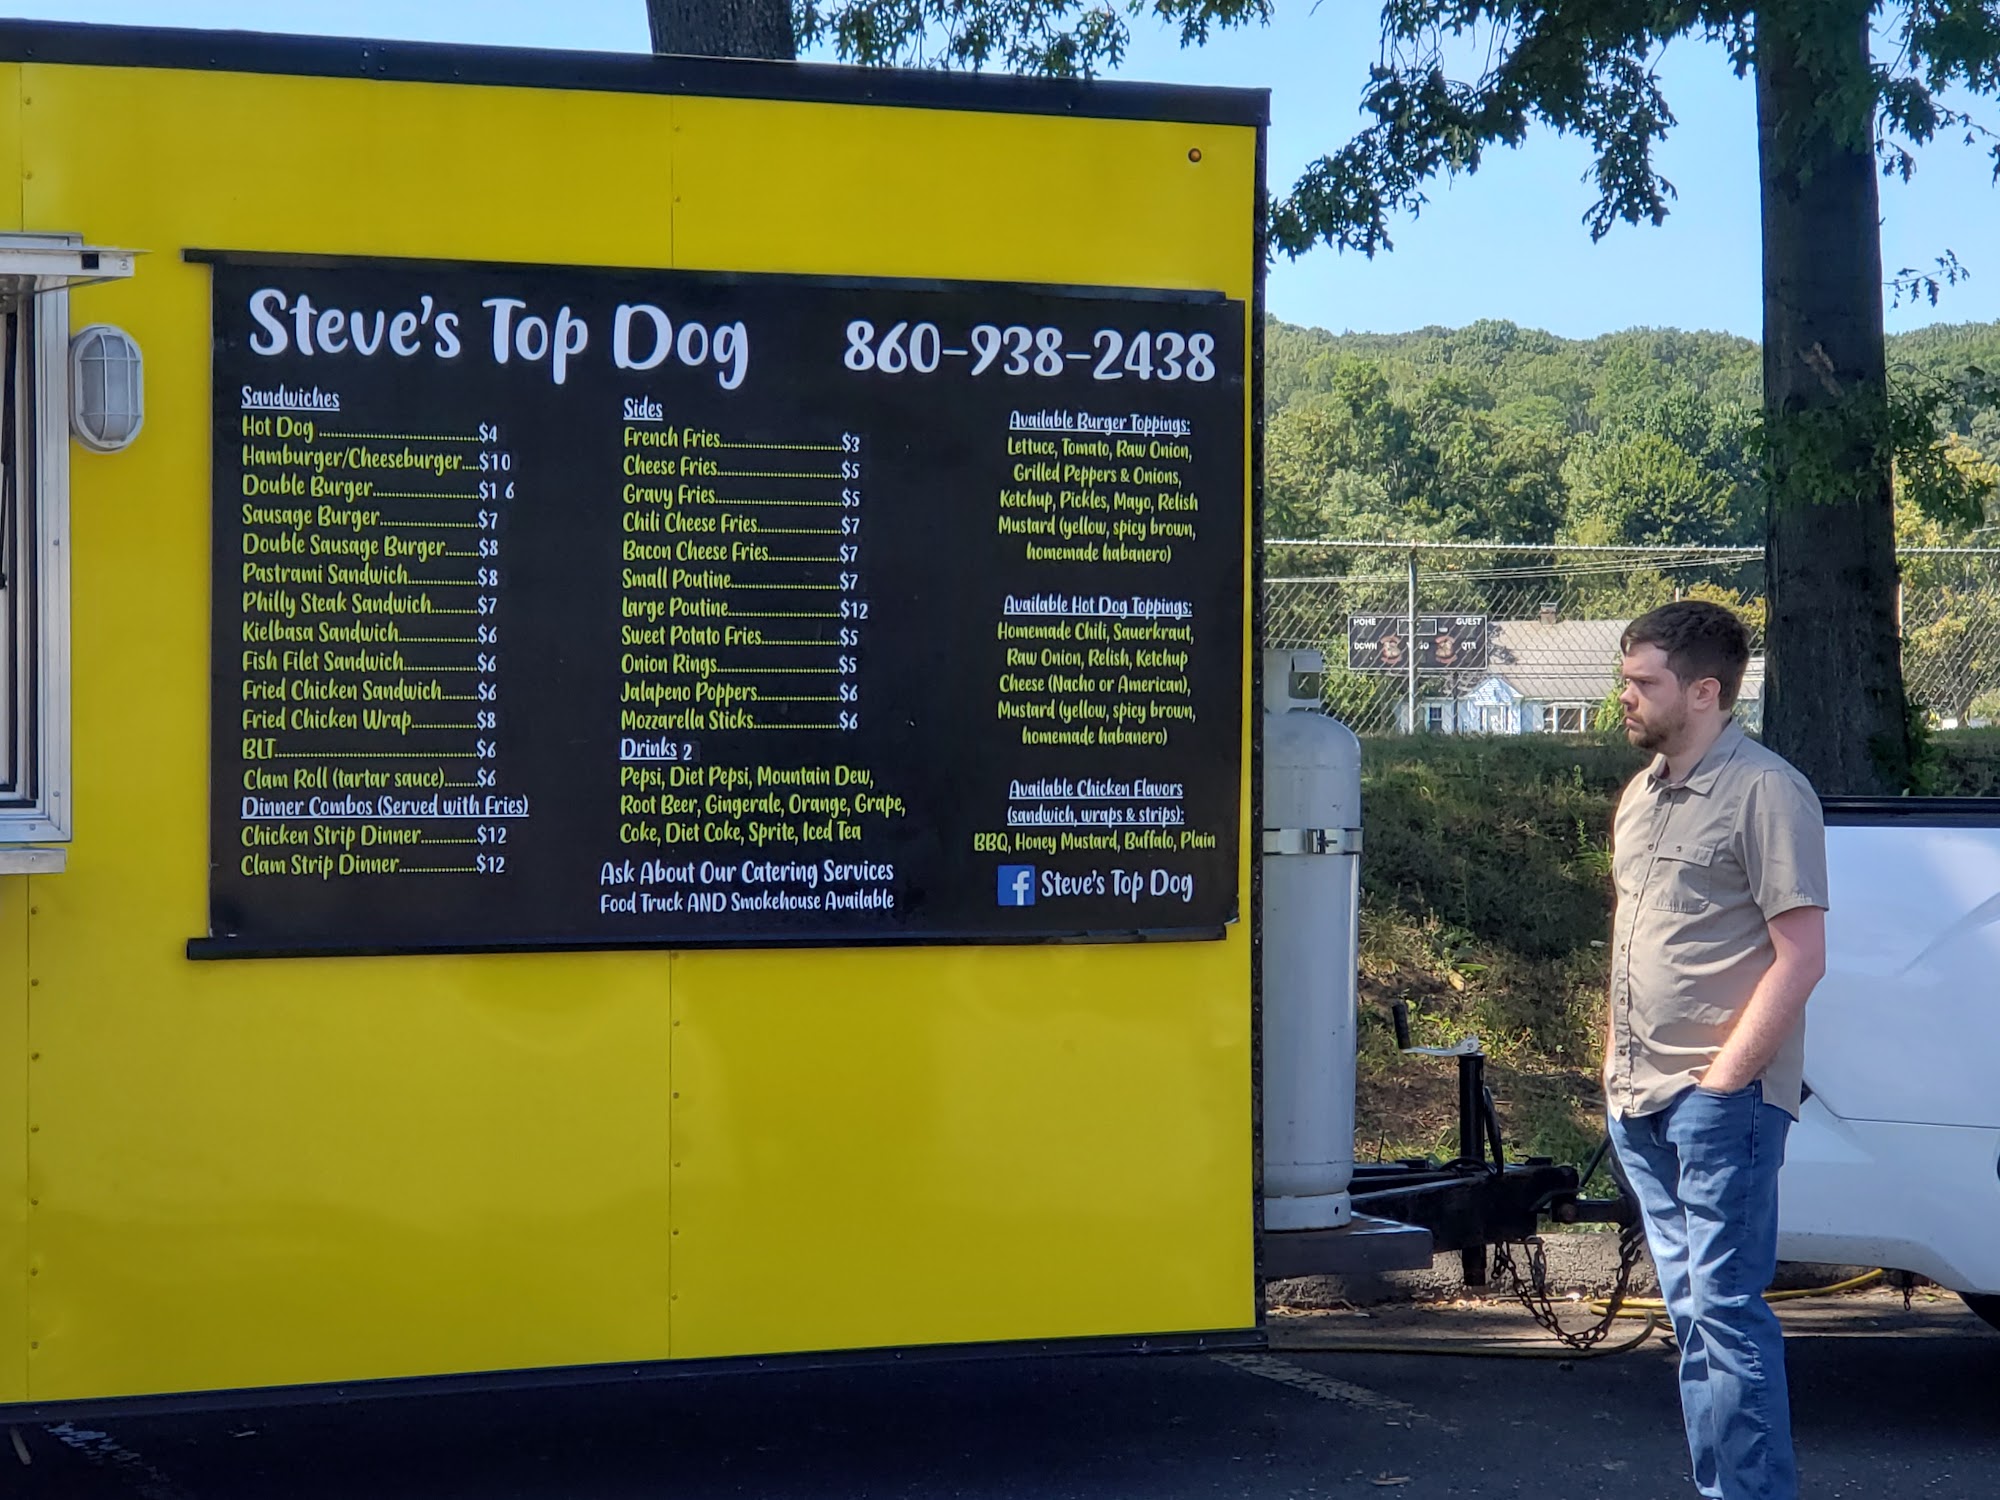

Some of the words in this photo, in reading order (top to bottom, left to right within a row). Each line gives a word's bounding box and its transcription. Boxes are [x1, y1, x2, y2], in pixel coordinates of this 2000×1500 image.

[249, 288, 462, 358] Steve's
[482, 298, 589, 385] Top
[612, 304, 749, 390] Dog
[843, 319, 1217, 383] 860-938-2438
[242, 384, 340, 410] Sandwiches
[623, 395, 663, 421] Sides
[242, 415, 271, 438] Hot
[276, 415, 314, 443] Dog
[478, 423, 498, 443] $4
[1009, 409, 1074, 430] Available
[1077, 411, 1127, 436] Burger
[1130, 413, 1191, 438] Toppings:
[624, 425, 678, 448] French
[683, 428, 721, 448] Fries
[842, 432, 860, 454] $3
[1007, 436, 1058, 459] Lettuce,
[1061, 438, 1112, 461] Tomato,
[1116, 440, 1146, 458] Raw
[1149, 440, 1192, 463] Onion,
[242, 444, 462, 477] Hamburger/Cheeseburger
[479, 452, 511, 472] $10
[1013, 463, 1060, 483] Grilled
[1064, 464, 1117, 488] Peppers
[1120, 467, 1130, 483] &
[1133, 467, 1182, 488] Onions,
[623, 483, 673, 510] Gravy
[678, 484, 715, 505] Fries
[842, 488, 860, 508] $5
[999, 489, 1056, 514] Ketchup,
[1060, 490, 1110, 513] Pickles,
[1113, 492, 1154, 516] Mayo,
[1158, 493, 1199, 512] Relish
[242, 503, 313, 526] Sausage
[317, 504, 380, 532] Burger
[478, 510, 499, 530] $7
[998, 515, 1056, 535] Mustard
[1059, 517, 1110, 540] (yellow,
[1113, 518, 1146, 541] spicy
[1150, 518, 1196, 541] brown,
[242, 532, 305, 555] Double
[310, 534, 379, 561] Sausage
[384, 535, 446, 562] Burger
[478, 538, 499, 558] $8
[622, 539, 671, 561] Bacon
[676, 540, 728, 561] Cheese
[732, 542, 768, 562] Fries
[840, 543, 858, 564] $7
[1026, 541, 1099, 561] homemade
[1102, 543, 1172, 564] habanero)
[622, 566, 668, 589] Small
[672, 568, 731, 589] Poutine
[840, 571, 858, 592] $7
[242, 590, 296, 618] Philly
[300, 591, 347, 613] Steak
[352, 591, 432, 614] Sandwich
[478, 595, 498, 616] $7
[1004, 593, 1069, 615] Available
[1072, 596, 1096, 614] Hot
[1099, 596, 1128, 620] Dog
[1131, 597, 1192, 620] Toppings:
[242, 620, 314, 643] Kielbasa
[318, 620, 399, 643] Sandwich
[477, 624, 498, 644] $6
[997, 620, 1071, 641] Homemade
[1075, 621, 1110, 644] Chili,
[1113, 622, 1194, 645] Sauerkraut,
[1456, 618, 1482, 626] GUEST
[621, 625, 665, 646] Sweet
[670, 625, 720, 646] Potato
[724, 625, 762, 646] Fries
[840, 626, 858, 647] $5
[1354, 642, 1378, 650] DOWN
[242, 678, 286, 701] Fried
[291, 678, 358, 701] Chicken
[362, 678, 442, 701] Sandwich
[477, 681, 497, 701] $6
[620, 680, 691, 707] Jalapeno
[695, 681, 757, 707] Poppers
[839, 682, 858, 703] $6
[999, 674, 1045, 693] Cheese
[1048, 674, 1095, 693] (Nacho
[1099, 678, 1114, 693] or
[1118, 674, 1191, 697] American),
[621, 709, 704, 731] Mozzarella
[708, 709, 753, 731] Sticks
[839, 710, 858, 731] $6
[620, 736, 678, 760] Drinks
[683, 743, 692, 761] 2
[1022, 725, 1095, 745] homemade
[1098, 726, 1168, 746] habanero)
[242, 737, 276, 761] BLT
[476, 739, 497, 760] $6
[243, 768, 289, 790] Clam
[294, 768, 328, 790] Roll
[333, 768, 390, 791] (tartar
[395, 768, 445, 791] sauce)
[477, 768, 497, 788] $6
[620, 765, 666, 792] Pepsi,
[670, 765, 704, 787] Diet
[708, 765, 752, 792] Pepsi,
[757, 765, 830, 787] Mountain
[834, 765, 874, 789] Dew,
[1009, 778, 1073, 799] Available
[1077, 778, 1130, 798] Chicken
[1134, 778, 1183, 798] Flavors
[241, 795, 304, 819] Dinner
[309, 795, 373, 819] Combos
[377, 794, 438, 819] (Served
[443, 794, 480, 819] with
[484, 794, 529, 819] Fries)
[620, 794, 656, 815] Root
[661, 794, 701, 818] Beer,
[789, 794, 851, 818] Orange,
[855, 794, 906, 818] Grape,
[1007, 805, 1078, 827] (sandwich,
[1081, 807, 1123, 828] wraps
[1126, 809, 1136, 823] &
[1139, 805, 1184, 828] strips):
[241, 823, 309, 847] Chicken
[313, 823, 356, 851] Strip
[361, 823, 421, 847] Dinner
[477, 825, 507, 845] $12
[619, 821, 661, 847] Coke,
[665, 821, 699, 843] Diet
[704, 821, 745, 846] Coke,
[749, 821, 799, 848] Sprite,
[803, 820, 833, 841] Iced
[837, 821, 861, 841] Tea
[974, 833, 1011, 854] BBQ,
[1015, 833, 1057, 855] Honey
[1060, 830, 1120, 852] Mustard,
[1124, 830, 1177, 852] Buffalo,
[1180, 831, 1216, 849] Plain
[600, 859, 635, 885] Ask
[640, 860, 695, 885] About
[700, 860, 737, 883] Our
[741, 860, 818, 889] Catering
[823, 859, 894, 882] Services
[1041, 869, 1105, 897] Steve's
[1111, 869, 1144, 903] Top
[1150, 869, 1193, 902] Dog
[600, 892, 636, 914] Food
[640, 891, 683, 914] Truck
[687, 892, 727, 914] AND
[731, 891, 821, 911] Smokehouse
[825, 889, 894, 911] Available
